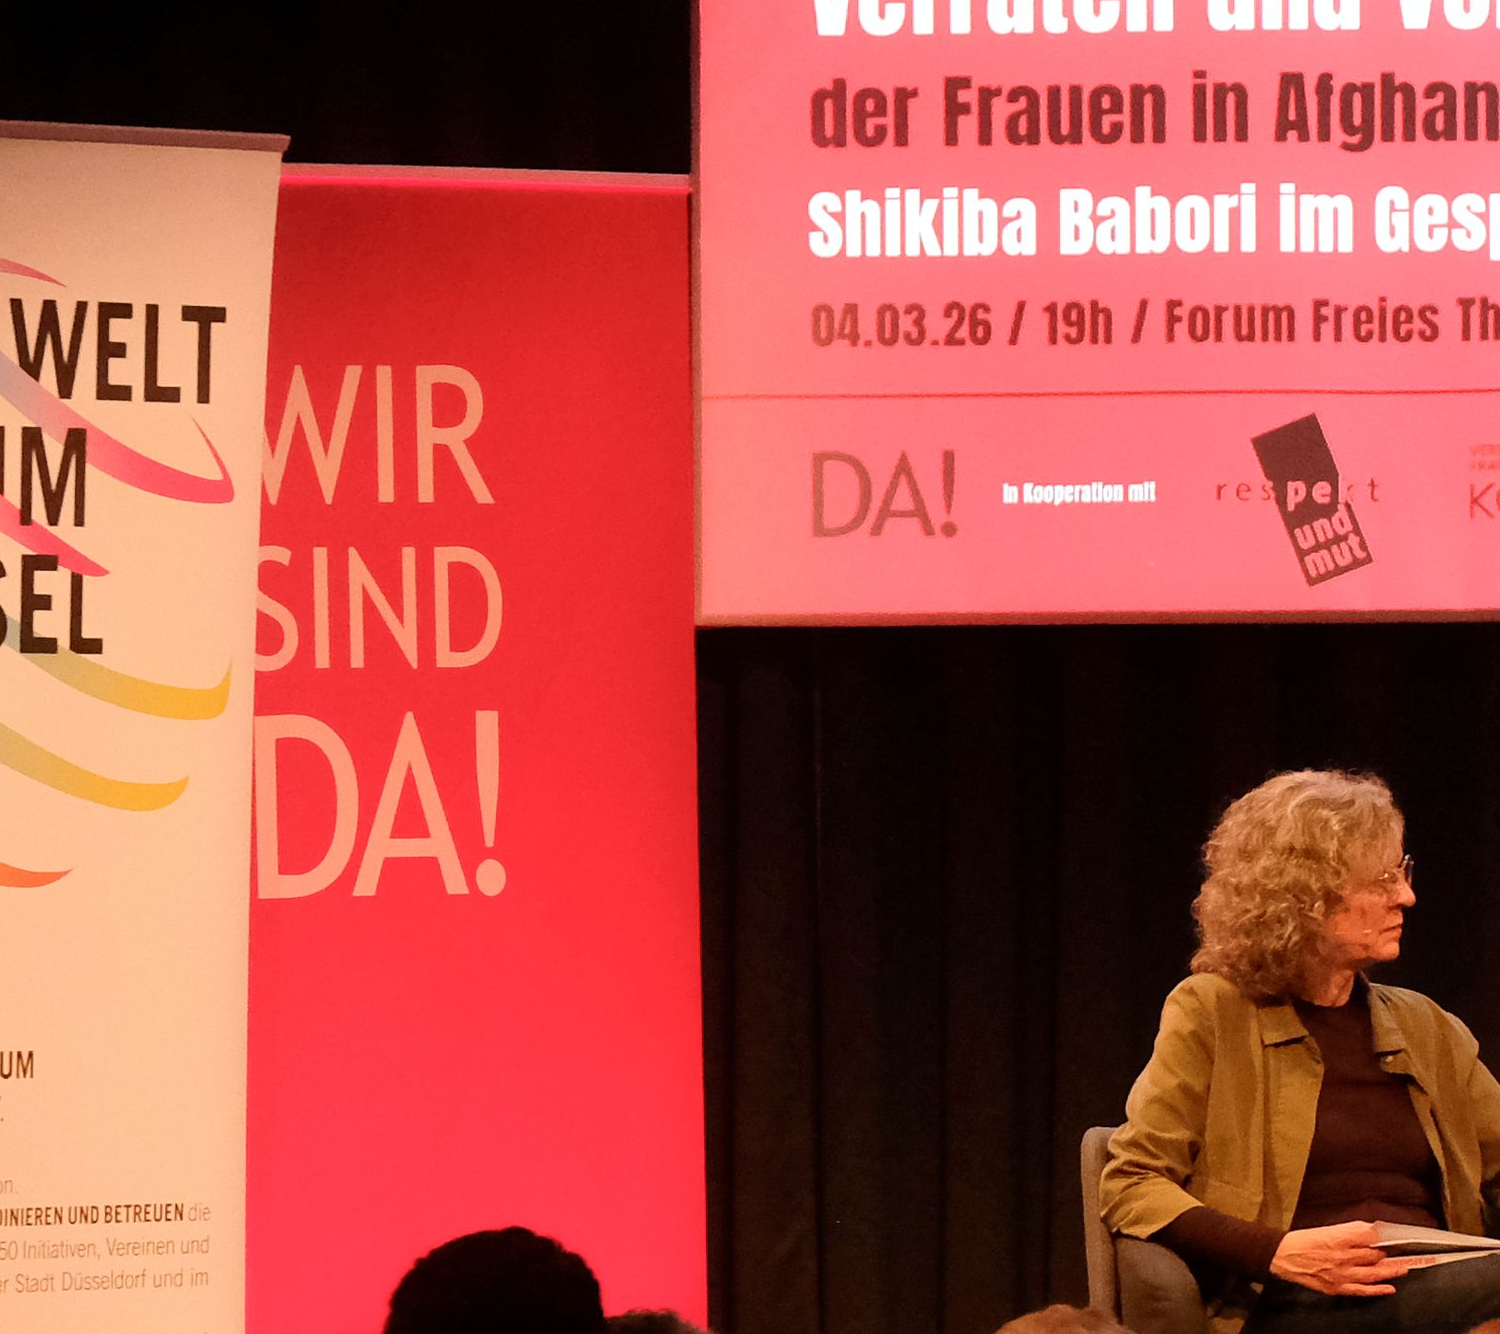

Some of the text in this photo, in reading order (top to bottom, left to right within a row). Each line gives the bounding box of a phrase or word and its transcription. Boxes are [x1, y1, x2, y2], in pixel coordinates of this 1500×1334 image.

[810, 77, 918, 149] der
[943, 75, 1167, 147] Frauen
[1191, 69, 1249, 144] in
[807, 186, 1038, 259] Shikiba
[1058, 182, 1257, 257] Babori
[1279, 182, 1354, 254] im
[9, 298, 227, 405] WELT
[810, 300, 993, 349] 04.03.26
[1008, 300, 1027, 347] /
[1042, 299, 1113, 346] 19h
[1130, 299, 1150, 345] /
[1164, 297, 1297, 344] Forum
[1311, 297, 1440, 344] Freies
[261, 364, 496, 505] WIR
[811, 449, 959, 539] DA!
[1023, 482, 1124, 506] Kooperation
[1128, 481, 1156, 503] mit
[1294, 503, 1354, 550] und
[1303, 533, 1367, 578] mut
[254, 545, 503, 671] SIND
[252, 709, 507, 900] DA!
[68, 1205, 99, 1225] UND
[104, 1203, 184, 1224] BETREUEN
[188, 1203, 211, 1222] die
[22, 1239, 100, 1260] Initiativen,
[106, 1237, 175, 1257] Vereinen
[180, 1235, 210, 1255] und
[15, 1273, 55, 1293] Stadt
[61, 1268, 148, 1292] Düsseldorf
[152, 1268, 183, 1288] und
[190, 1268, 209, 1287] im
